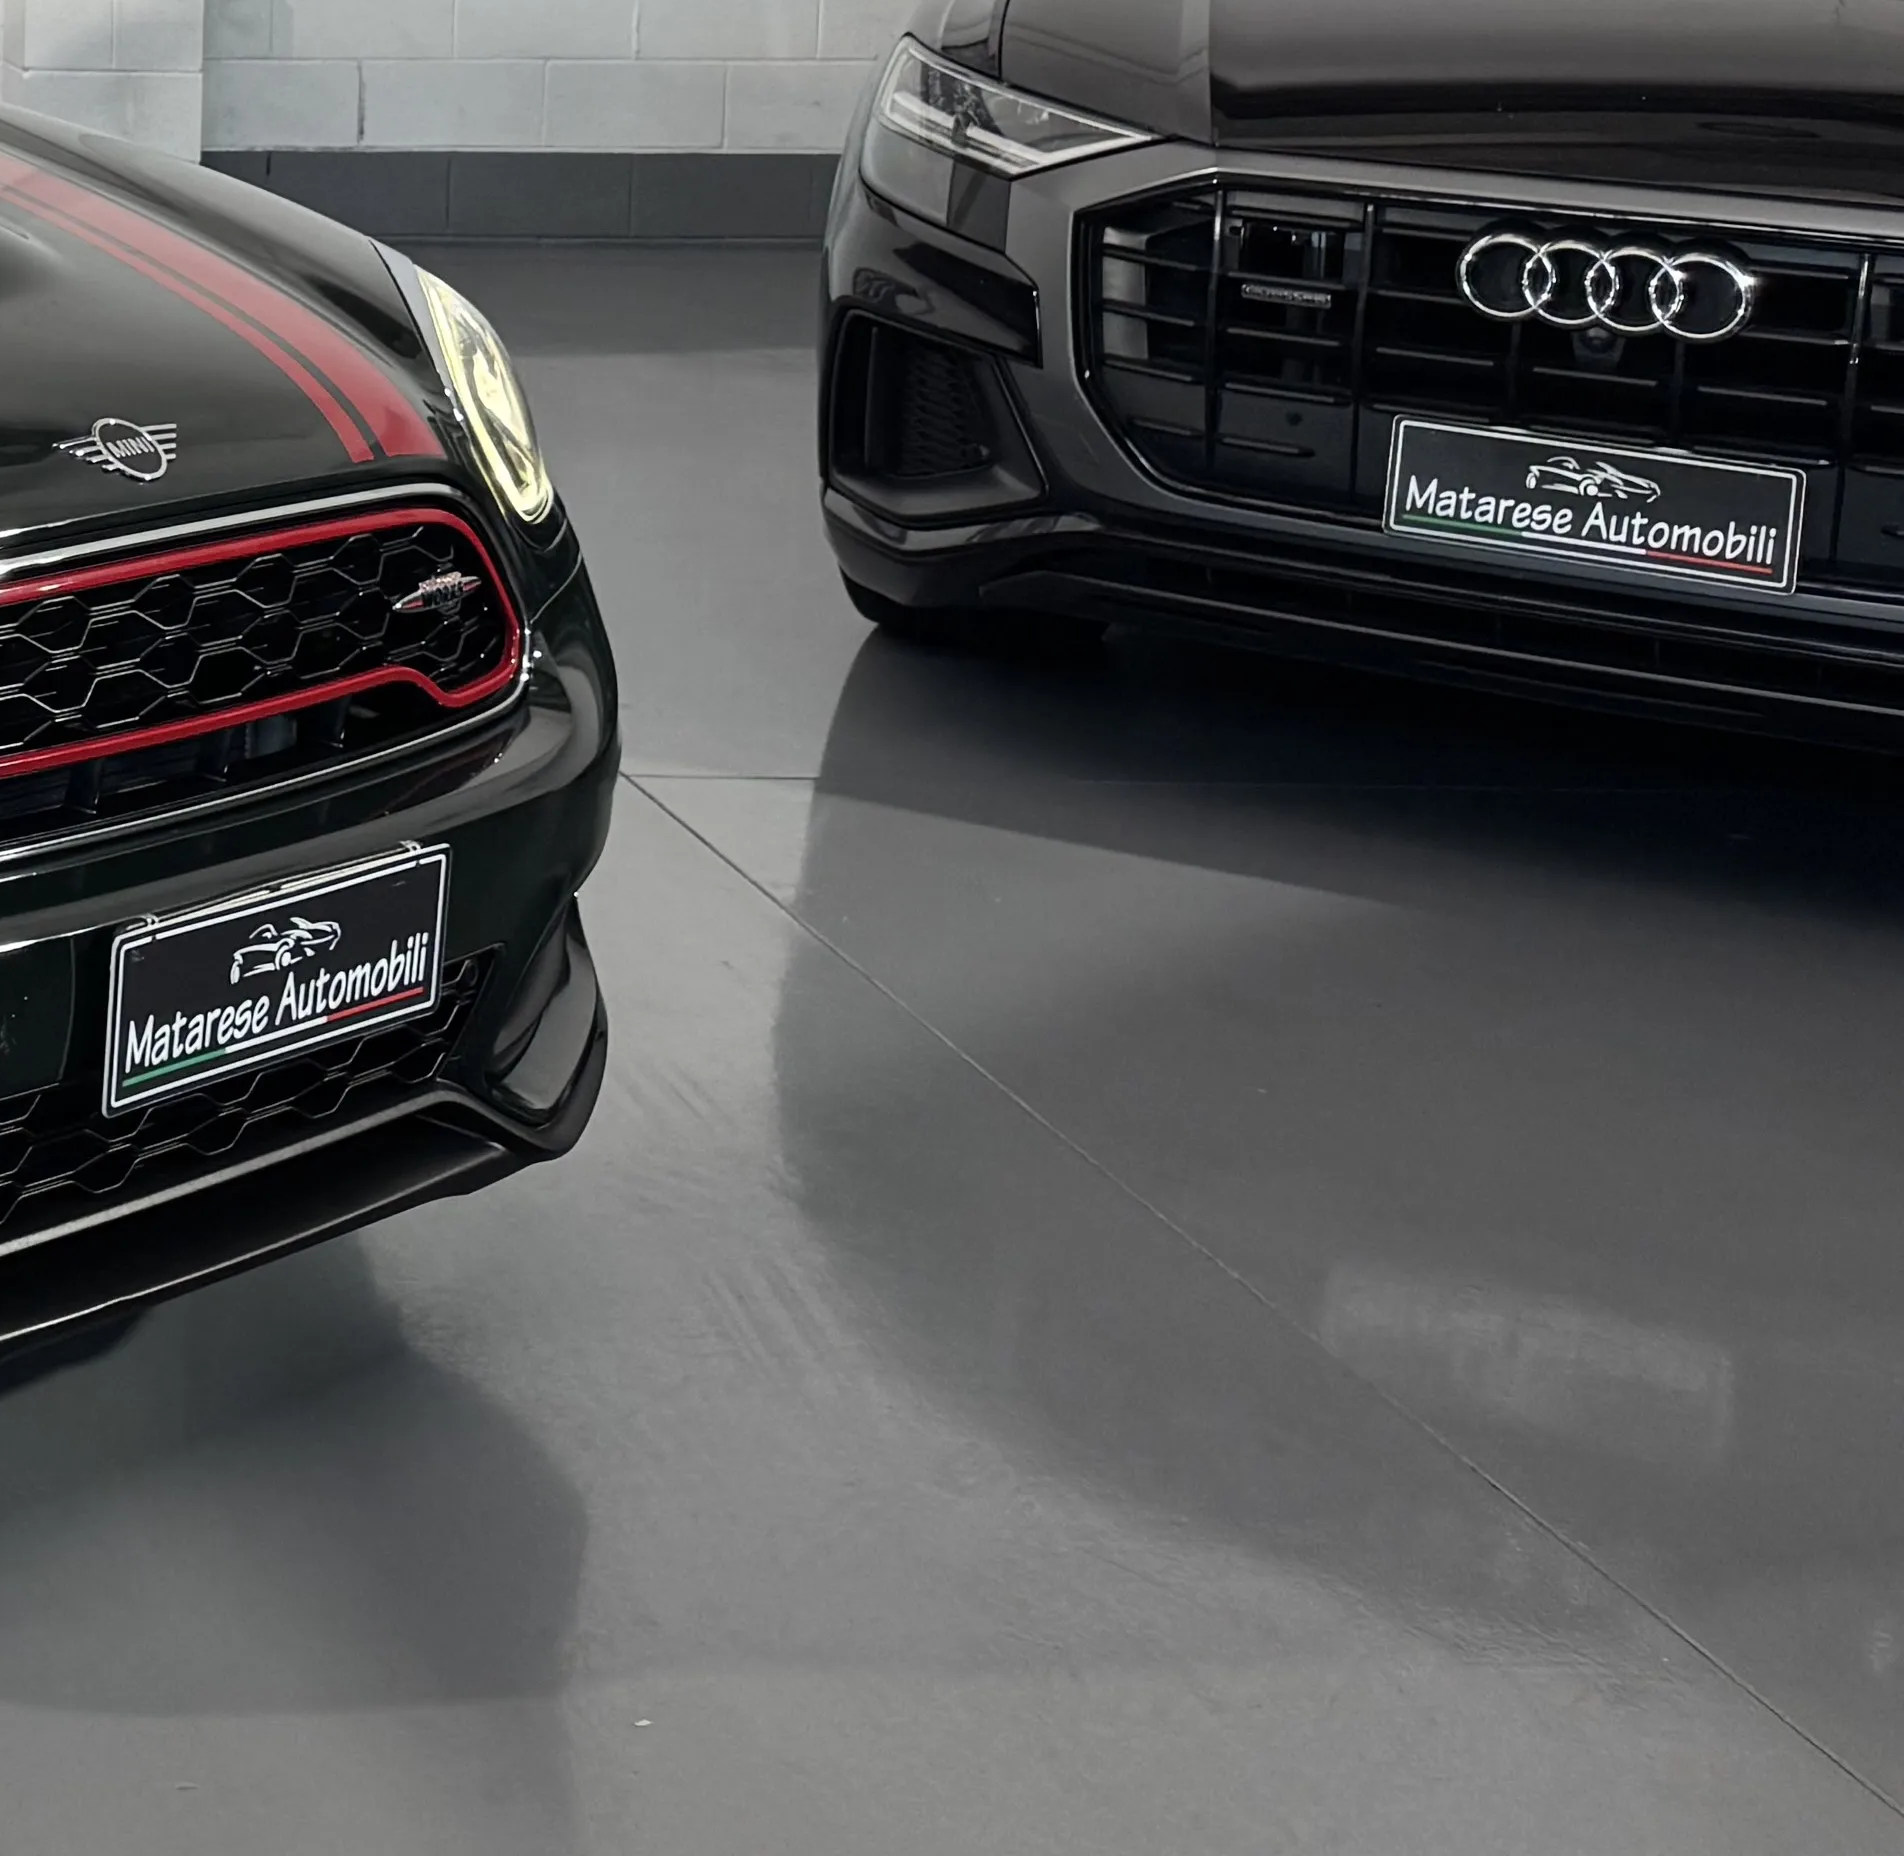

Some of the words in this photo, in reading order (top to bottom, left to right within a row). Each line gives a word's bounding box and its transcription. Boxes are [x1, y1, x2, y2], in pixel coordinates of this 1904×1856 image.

[105, 435, 155, 459] MINI
[1405, 474, 1573, 535] Matarese
[1580, 501, 1777, 565] Automobili
[124, 995, 270, 1074] Matarese
[274, 932, 429, 1026] Automobili
